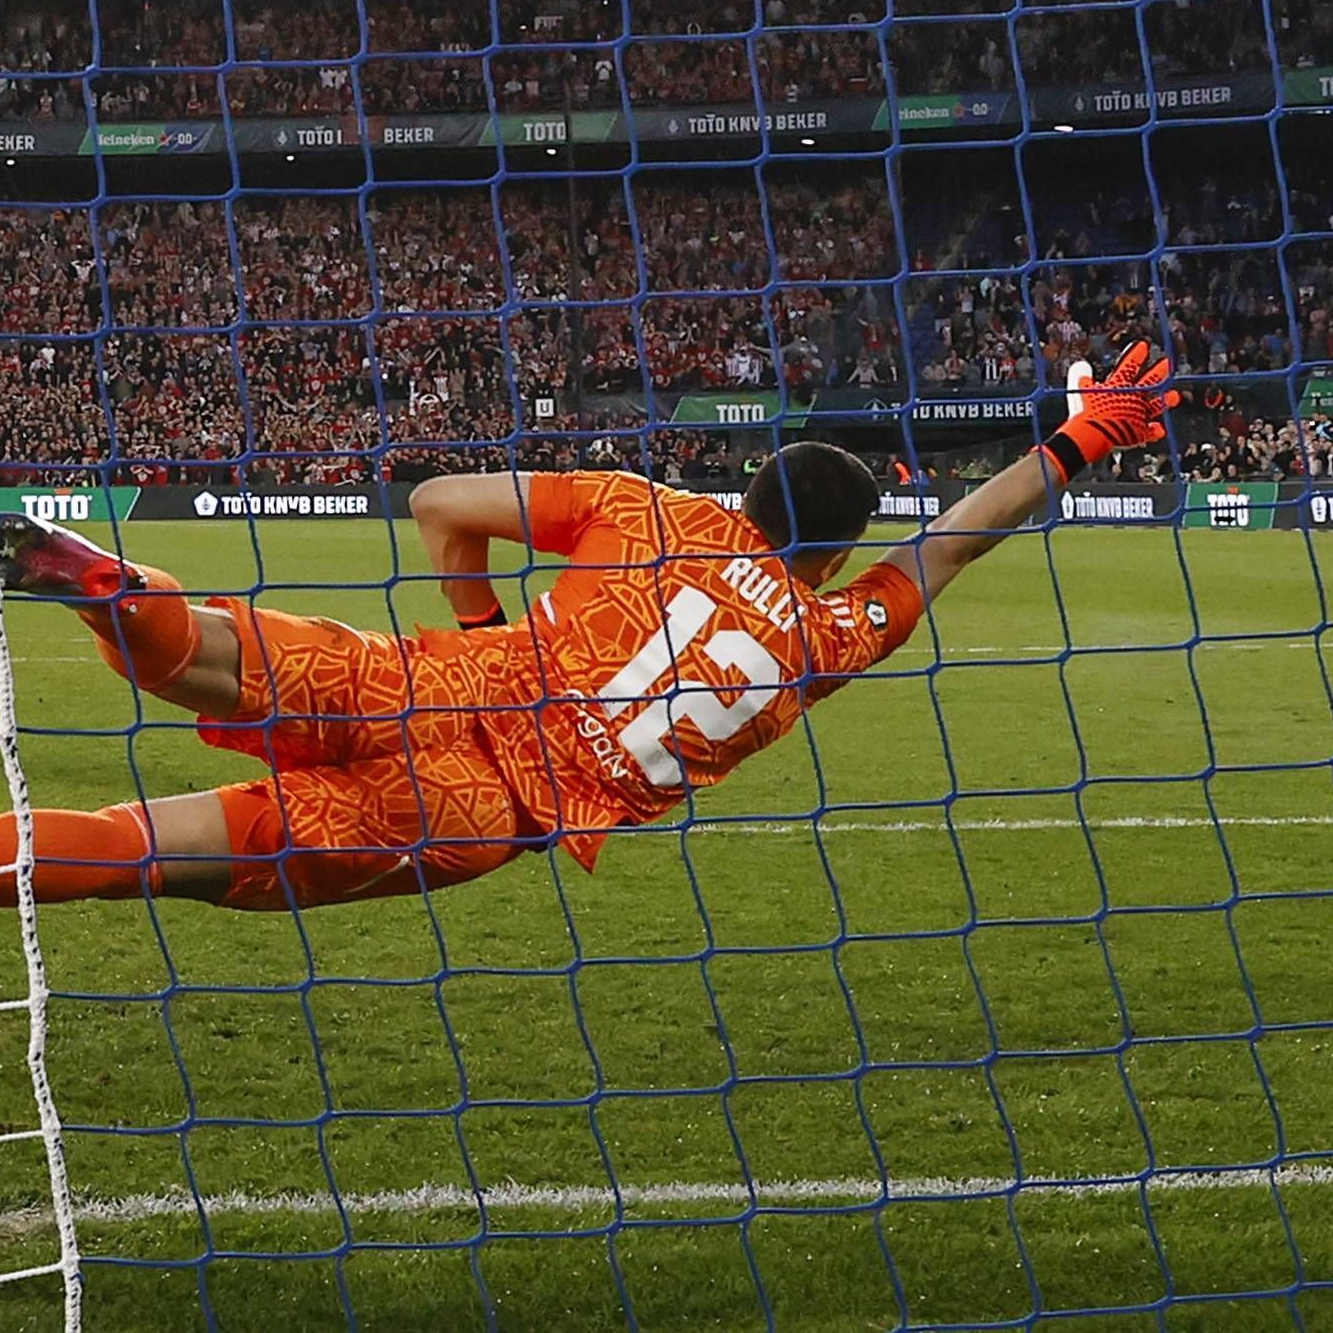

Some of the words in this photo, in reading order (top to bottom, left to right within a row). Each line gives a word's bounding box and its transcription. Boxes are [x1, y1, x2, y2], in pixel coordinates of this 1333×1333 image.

[1094, 91, 1131, 111] TOTO
[1181, 87, 1231, 106] BEKER
[896, 105, 949, 120] eineken
[523, 122, 566, 141] TOTO
[688, 114, 725, 133] TOTO
[776, 113, 827, 130] BEKER
[297, 126, 331, 145] TOTO
[384, 127, 434, 144] BEKER
[716, 404, 765, 424] TOTO
[21, 494, 89, 521] TOTO
[264, 496, 311, 514] KNVB
[313, 496, 368, 514] BEKER
[712, 493, 743, 511] NVB
[1075, 491, 1096, 517] TOTO
[1097, 497, 1121, 517] KNVB
[1122, 497, 1154, 517] BEKER
[1207, 494, 1250, 526] TOTO
[719, 557, 806, 633] RULLI
[597, 585, 781, 786] 12
